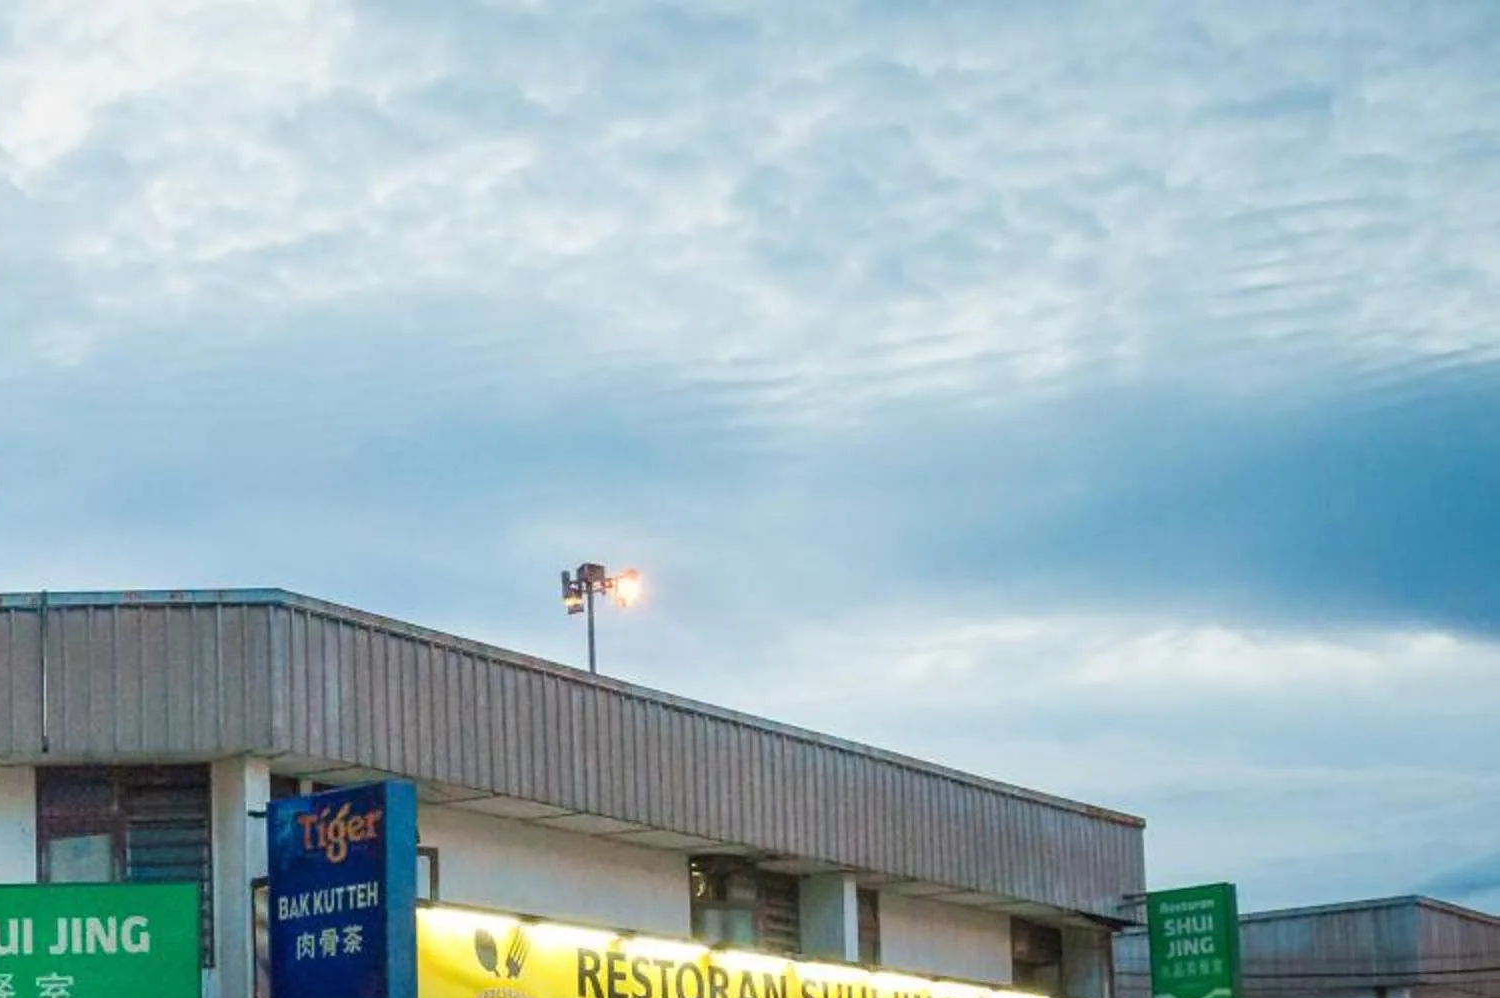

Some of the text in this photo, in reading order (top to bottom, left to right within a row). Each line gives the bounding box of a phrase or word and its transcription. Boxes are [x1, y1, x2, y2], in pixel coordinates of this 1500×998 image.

[297, 802, 384, 863] Tiger
[278, 881, 380, 921] BAK KUT TEH
[49, 915, 152, 955] JING
[296, 924, 364, 960] 肉骨茶
[1164, 915, 1214, 937] SHUI
[1166, 936, 1215, 959] JING
